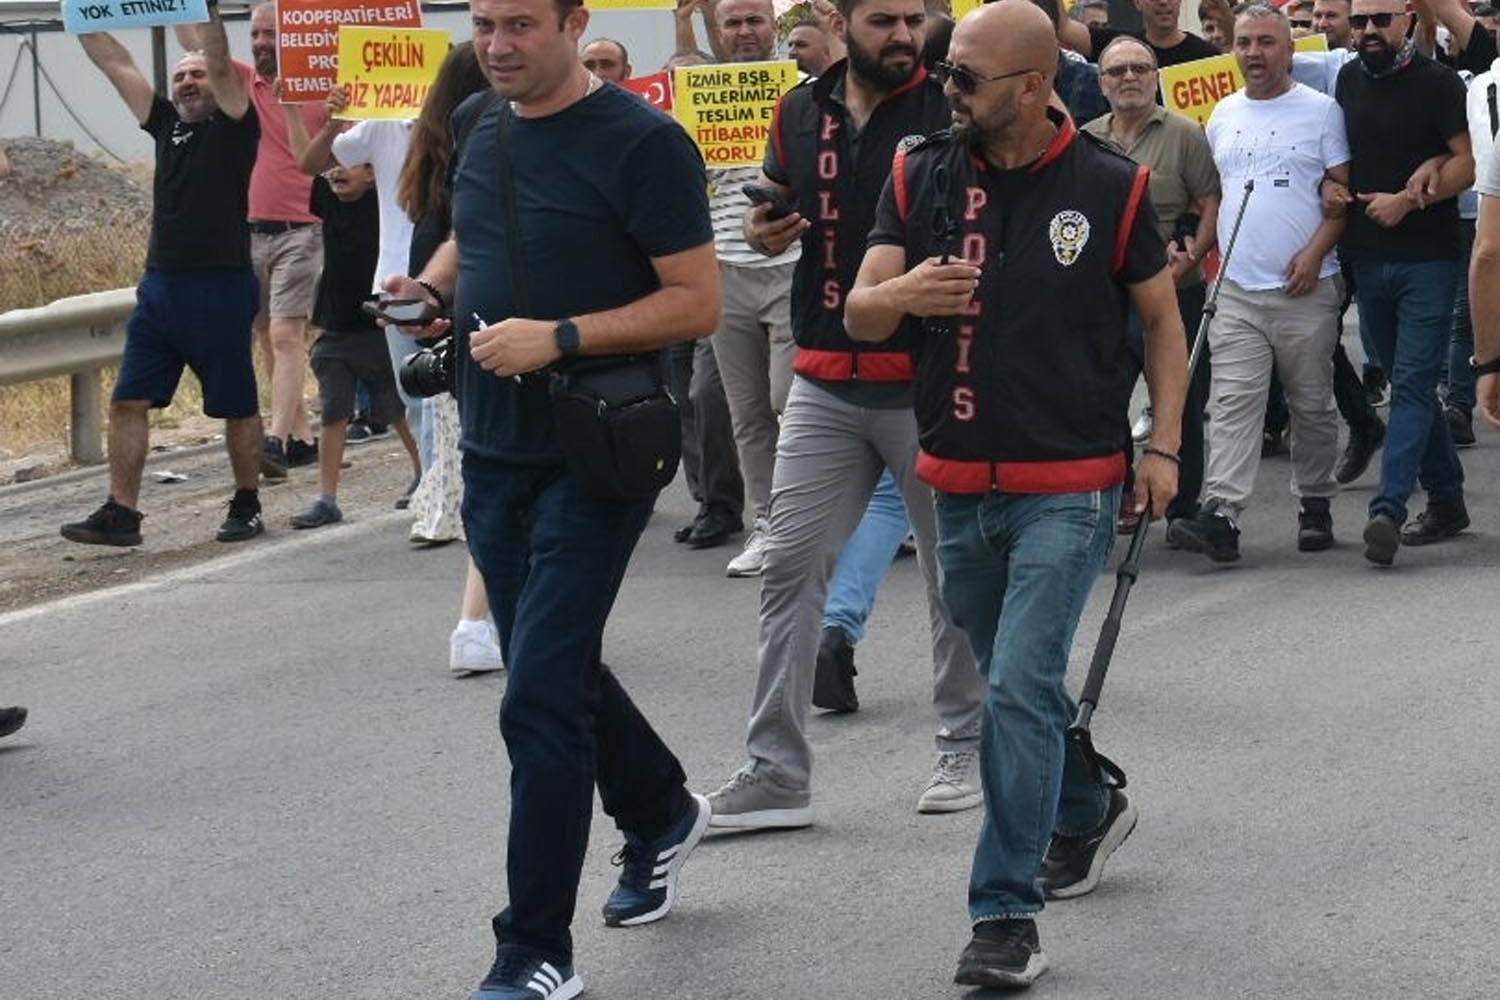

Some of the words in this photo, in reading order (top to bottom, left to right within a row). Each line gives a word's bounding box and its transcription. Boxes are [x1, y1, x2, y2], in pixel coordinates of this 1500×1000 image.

[79, 6, 114, 21] YOK
[282, 1, 413, 25] KOOPERATİFLERİ
[281, 29, 338, 48] BELEDİY
[308, 55, 338, 70] PRO
[362, 35, 424, 72] ÇEKİLİN
[687, 69, 732, 88] İZMİR
[738, 69, 775, 87] BŞB.
[344, 75, 368, 107] BİZ
[373, 83, 427, 108] YAPALI
[692, 84, 781, 105] EVLERİMİZİ
[696, 105, 754, 123] TESLİM
[696, 123, 770, 143] İTİBARIN
[705, 146, 756, 162] KORU
[953, 187, 987, 421] POİS
